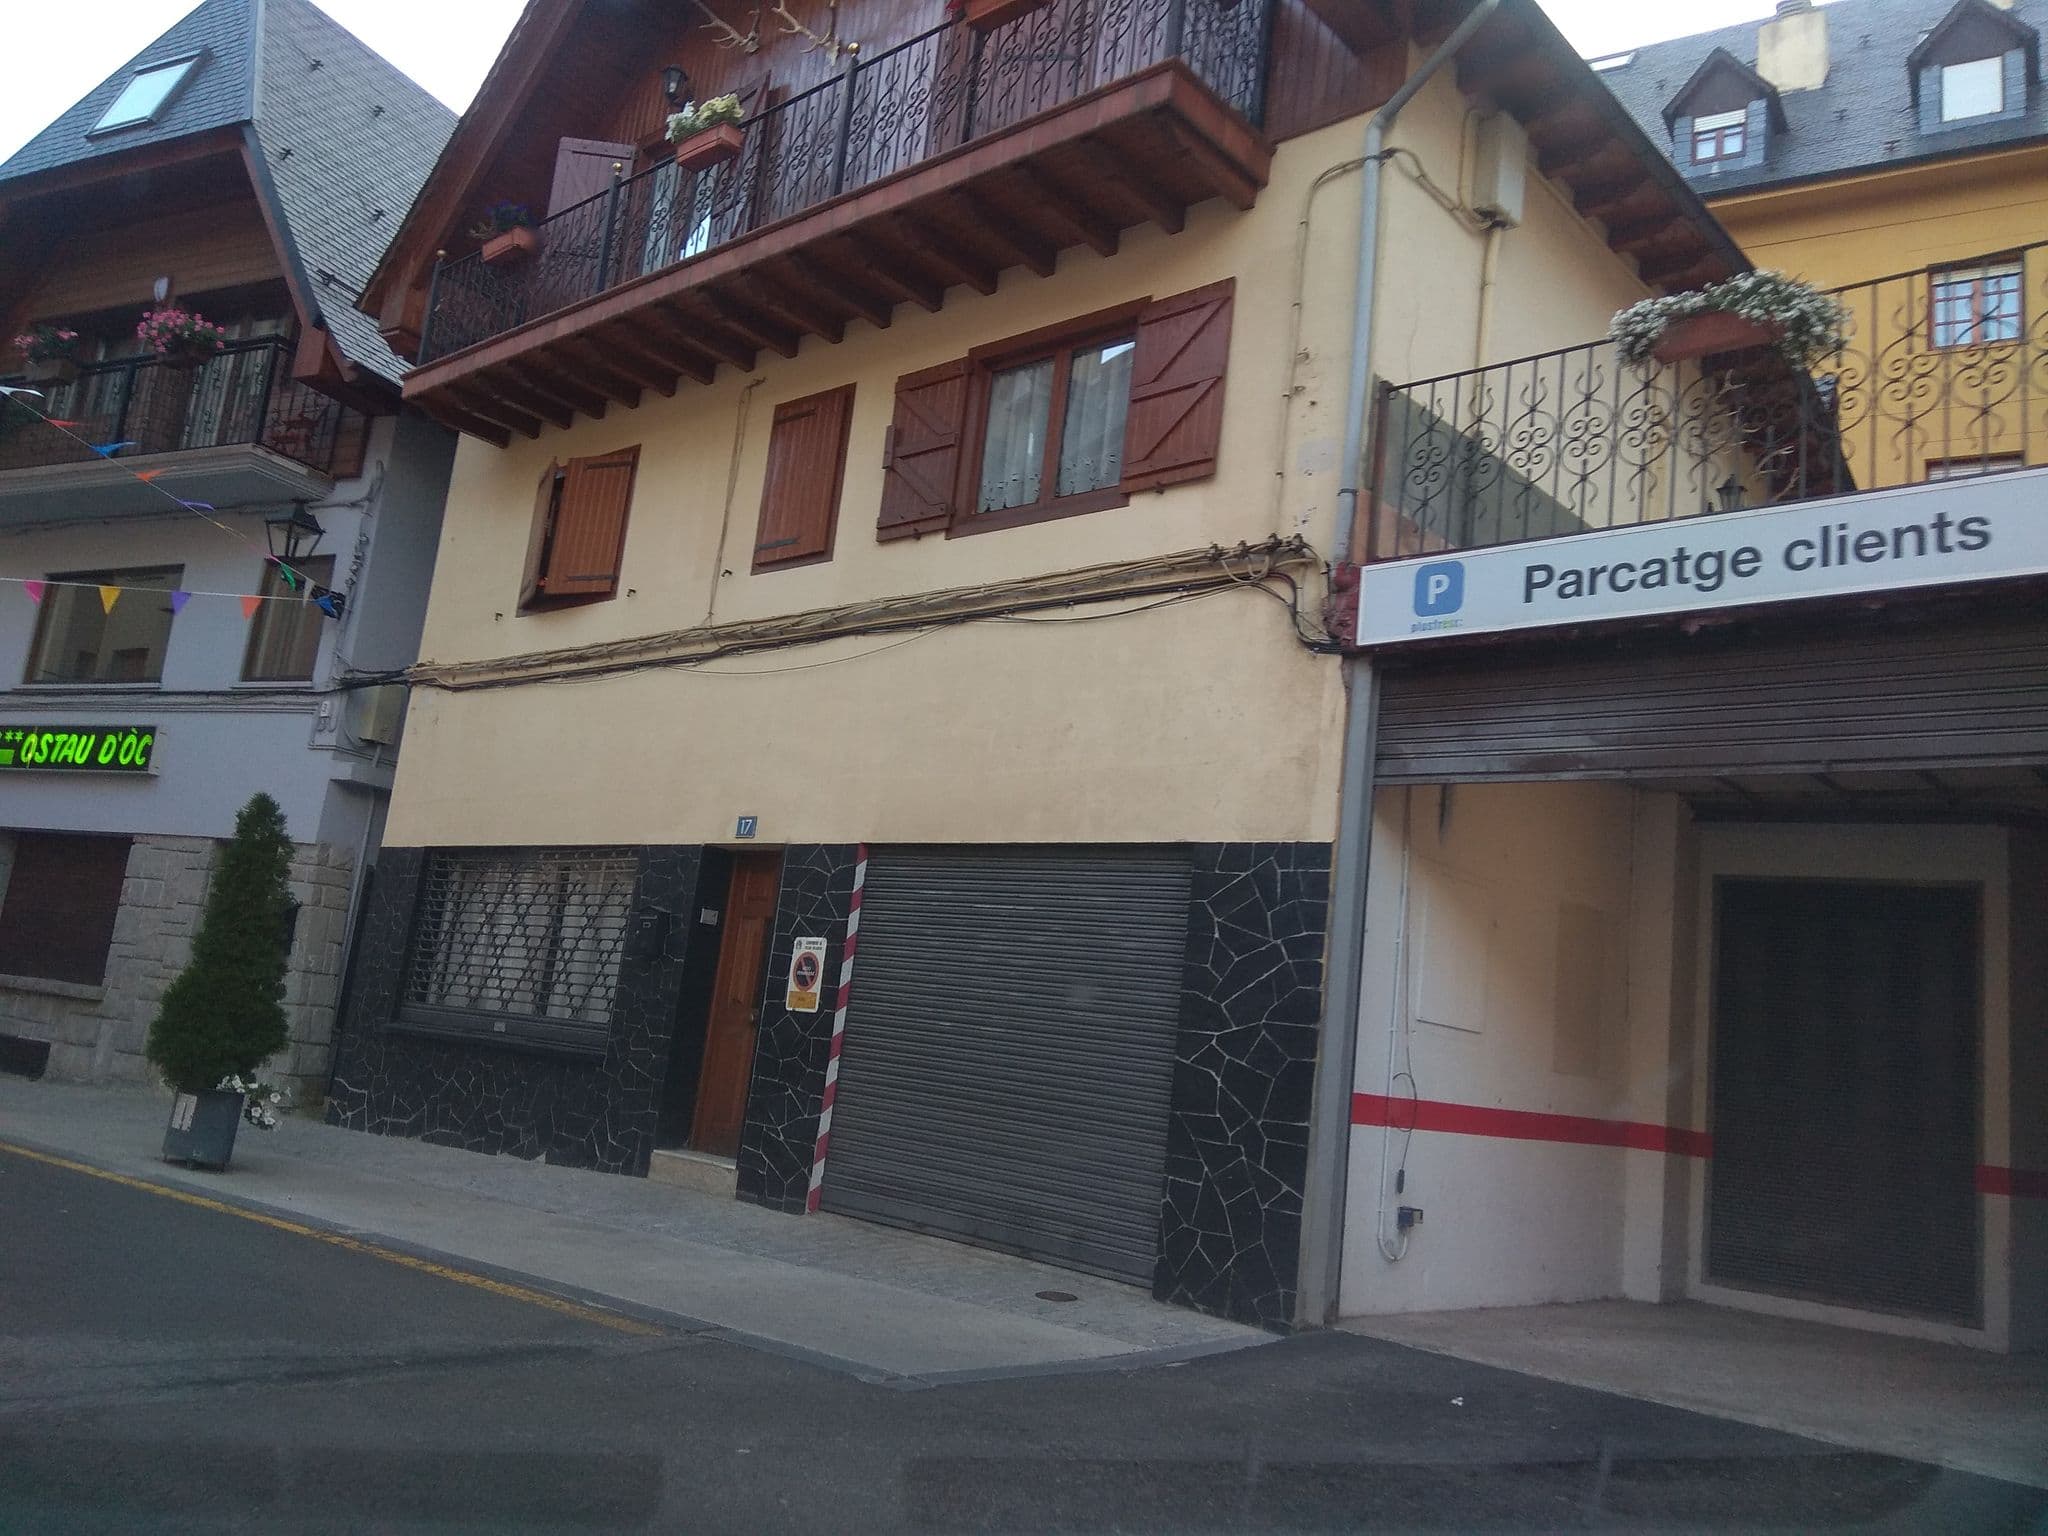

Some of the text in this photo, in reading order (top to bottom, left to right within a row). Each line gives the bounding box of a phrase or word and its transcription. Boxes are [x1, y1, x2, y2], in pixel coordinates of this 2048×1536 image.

[1523, 511, 1993, 604] Parcatge clients
[1427, 574, 1451, 605] P
[20, 732, 97, 765] OSTAU
[740, 819, 753, 835] 17
